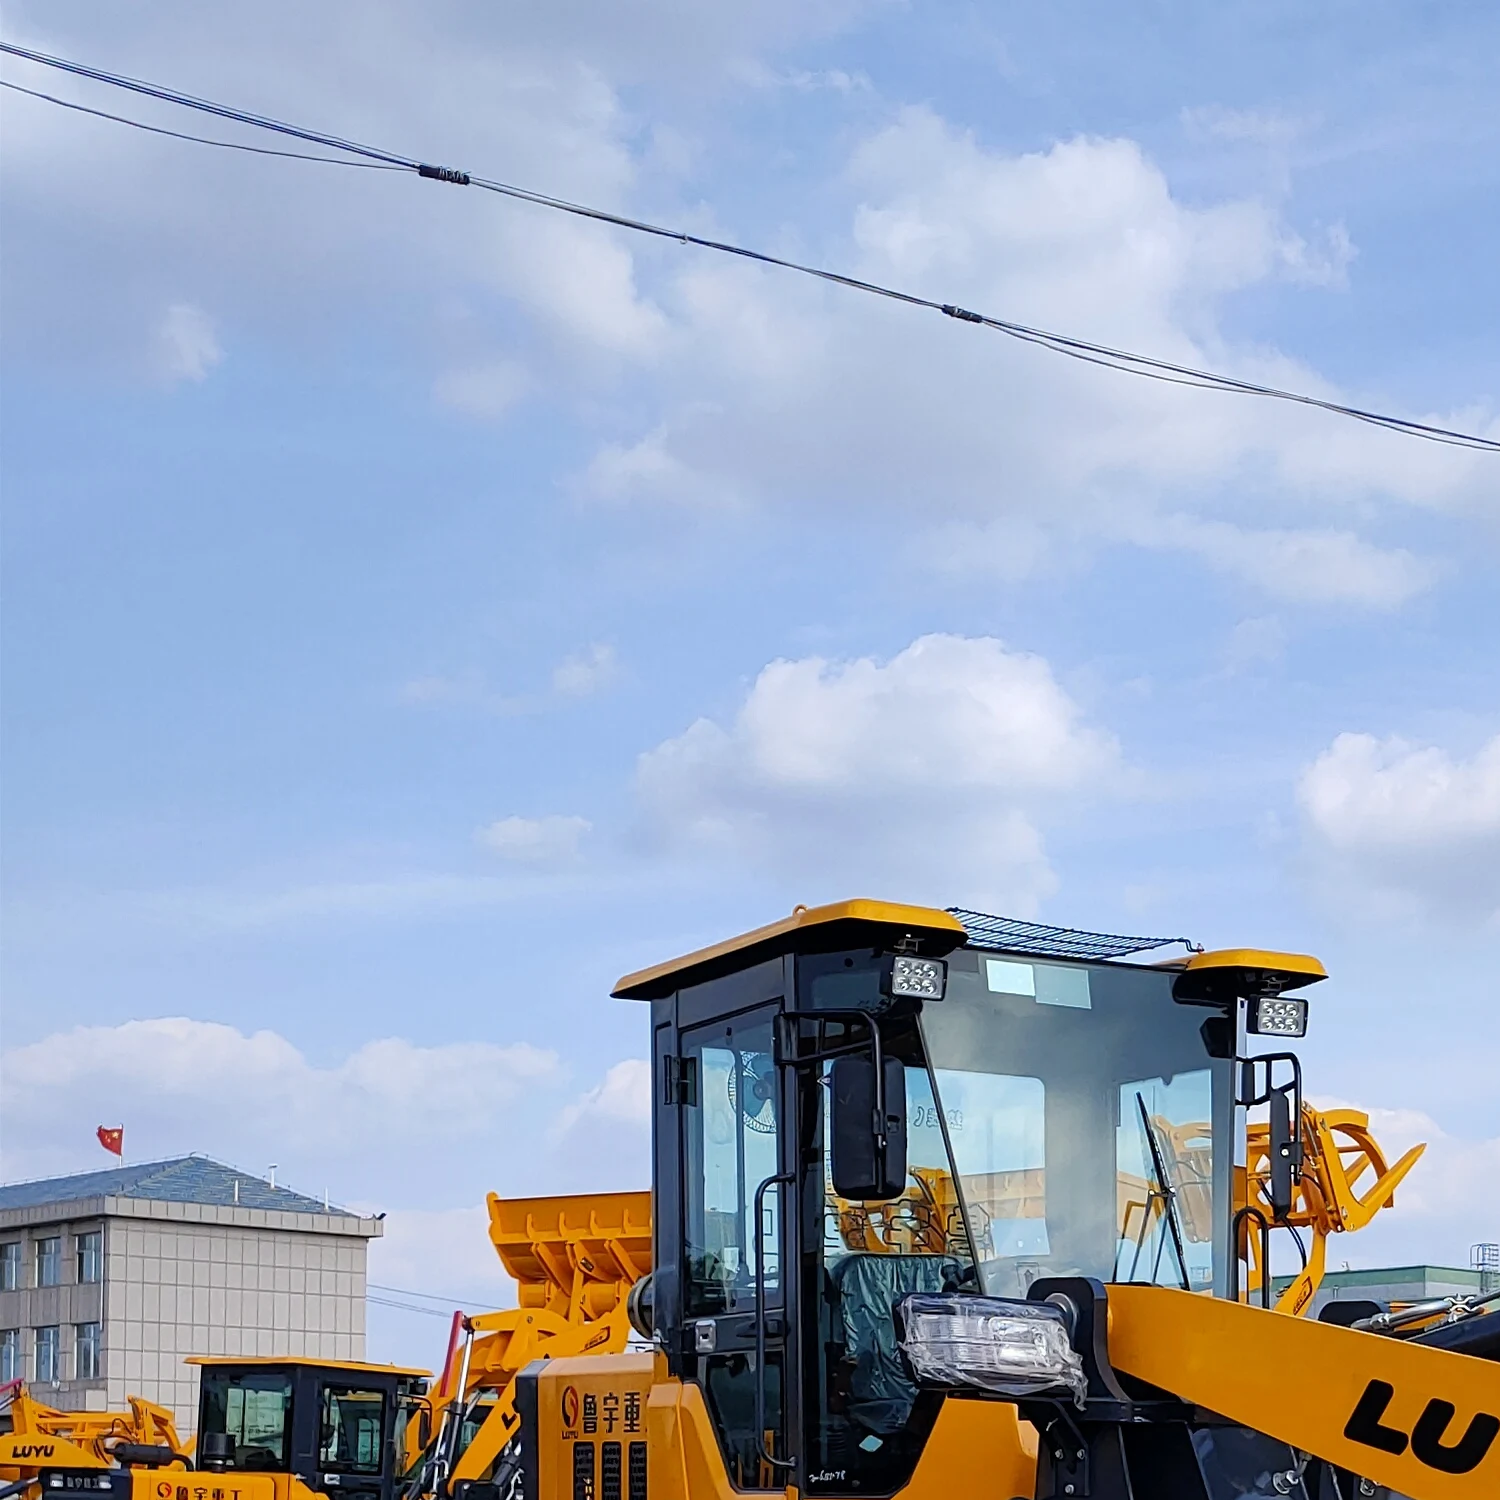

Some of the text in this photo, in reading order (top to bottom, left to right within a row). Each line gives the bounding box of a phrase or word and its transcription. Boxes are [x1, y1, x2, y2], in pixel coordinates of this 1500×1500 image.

[582, 1391, 648, 1434] 鲁宇重
[12, 1444, 55, 1459] LUYU
